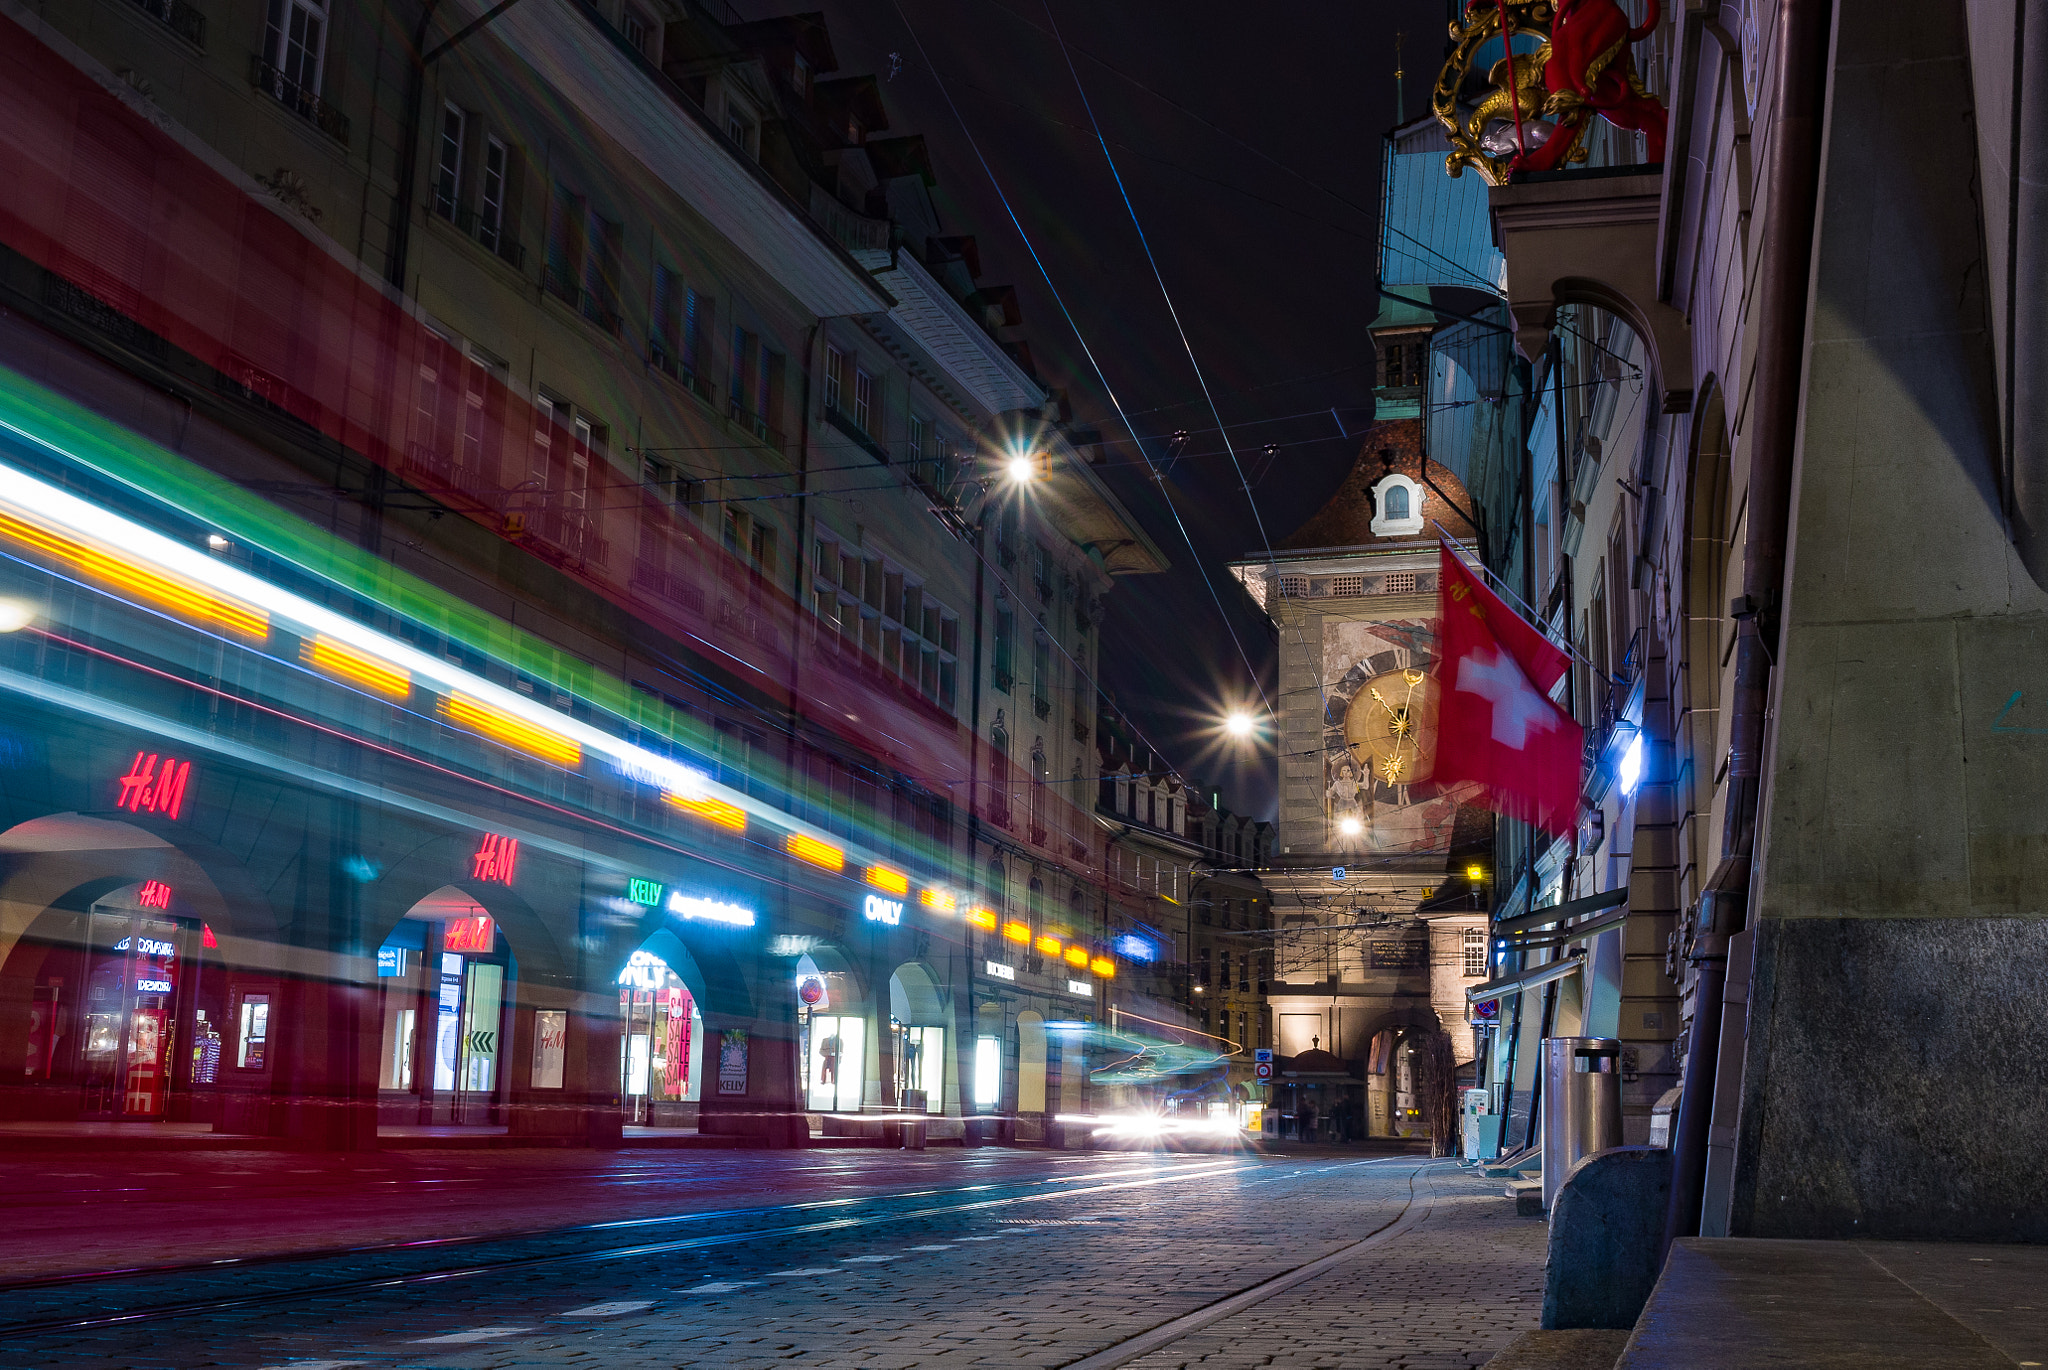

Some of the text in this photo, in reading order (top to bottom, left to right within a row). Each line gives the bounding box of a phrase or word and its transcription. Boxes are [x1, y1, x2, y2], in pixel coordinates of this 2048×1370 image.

[118, 751, 190, 820] H&M
[473, 832, 518, 886] H&M
[1334, 869, 1344, 878] 12
[140, 880, 171, 909] H&M
[630, 878, 662, 907] KELLY
[865, 894, 903, 926] ONLY
[445, 919, 491, 951] H&M
[670, 997, 692, 1021] SALE
[540, 1030, 566, 1050] H&M
[669, 1019, 691, 1043] SALE
[668, 1041, 690, 1065] SALE
[666, 1063, 689, 1087] SALE
[719, 1080, 745, 1091] KELLY
